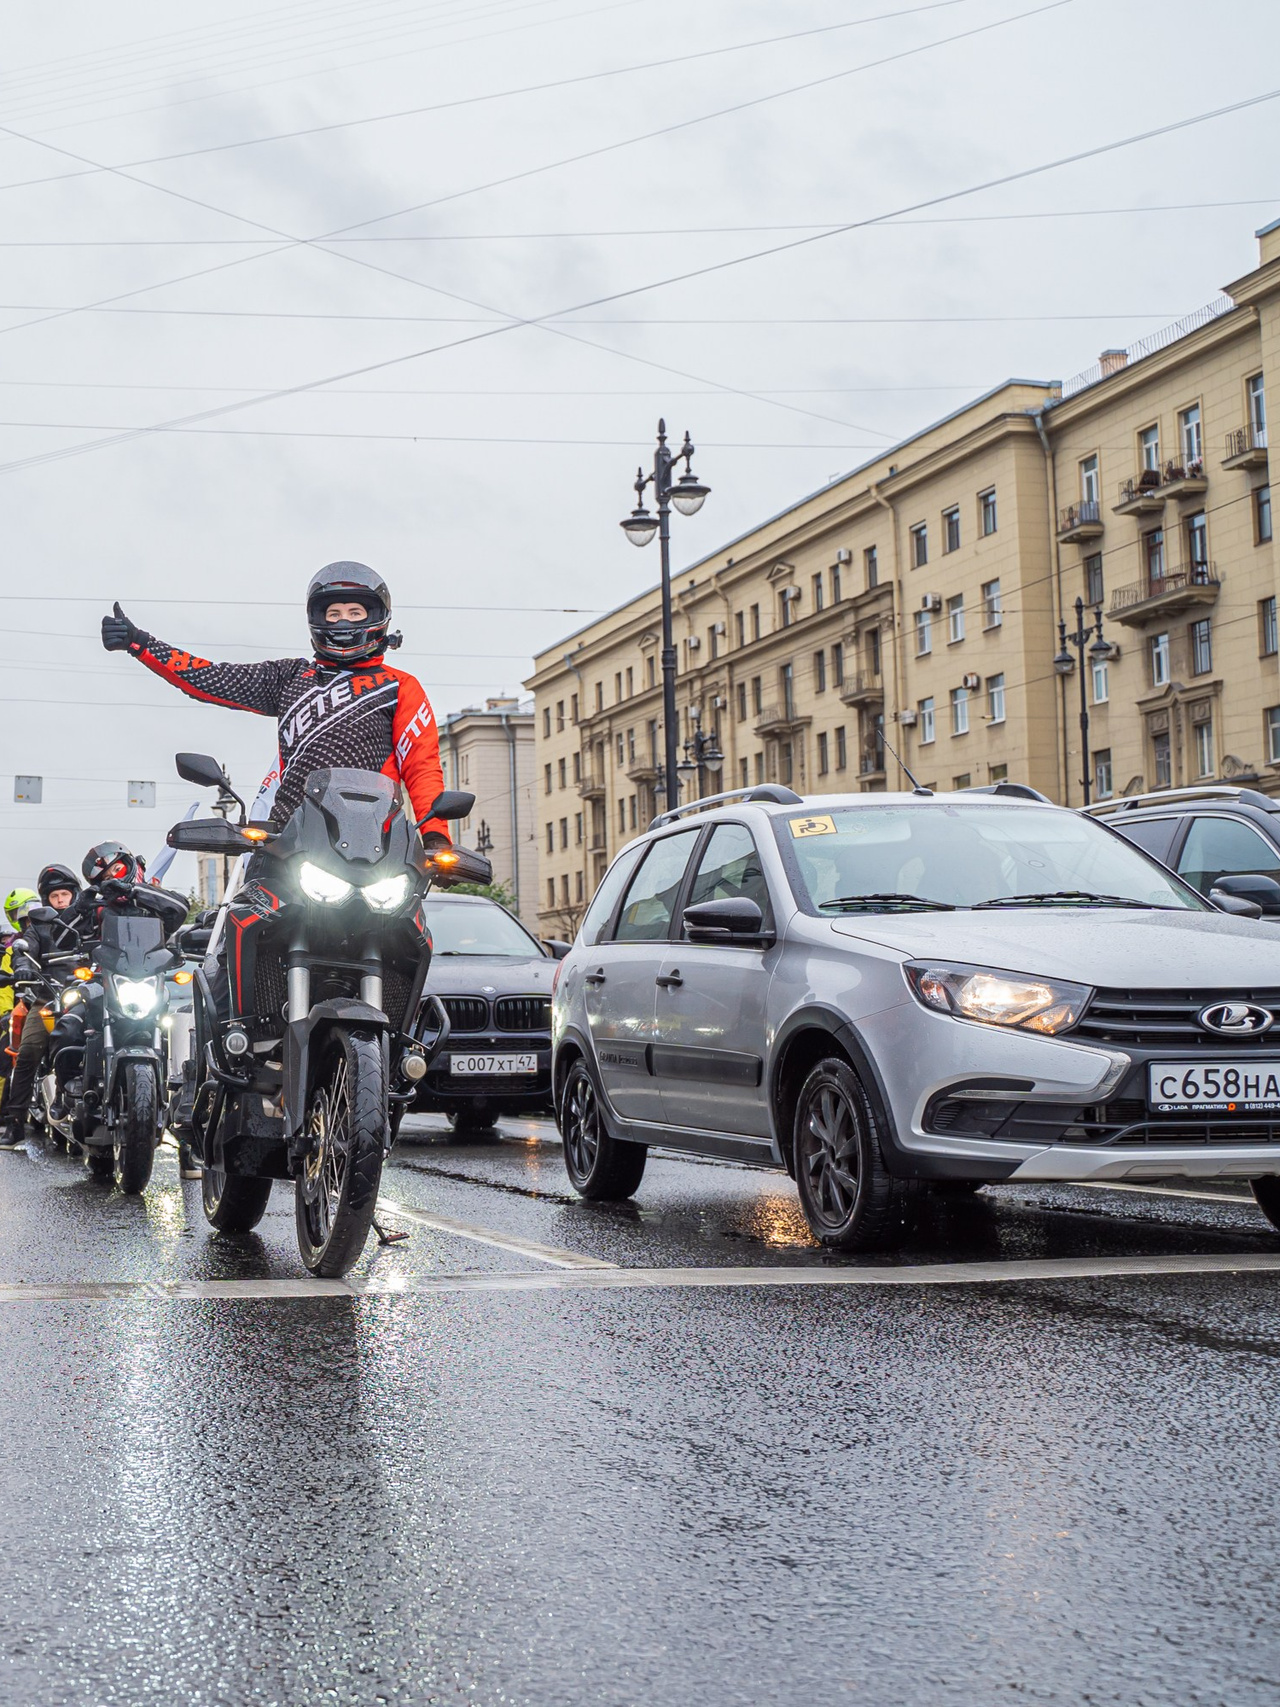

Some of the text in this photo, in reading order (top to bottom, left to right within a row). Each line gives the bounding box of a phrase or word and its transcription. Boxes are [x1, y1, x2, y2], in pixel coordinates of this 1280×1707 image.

[282, 671, 399, 747] VETERR
[456, 1056, 532, 1071] С007ХТ 47
[1160, 1068, 1280, 1099] С658НА
